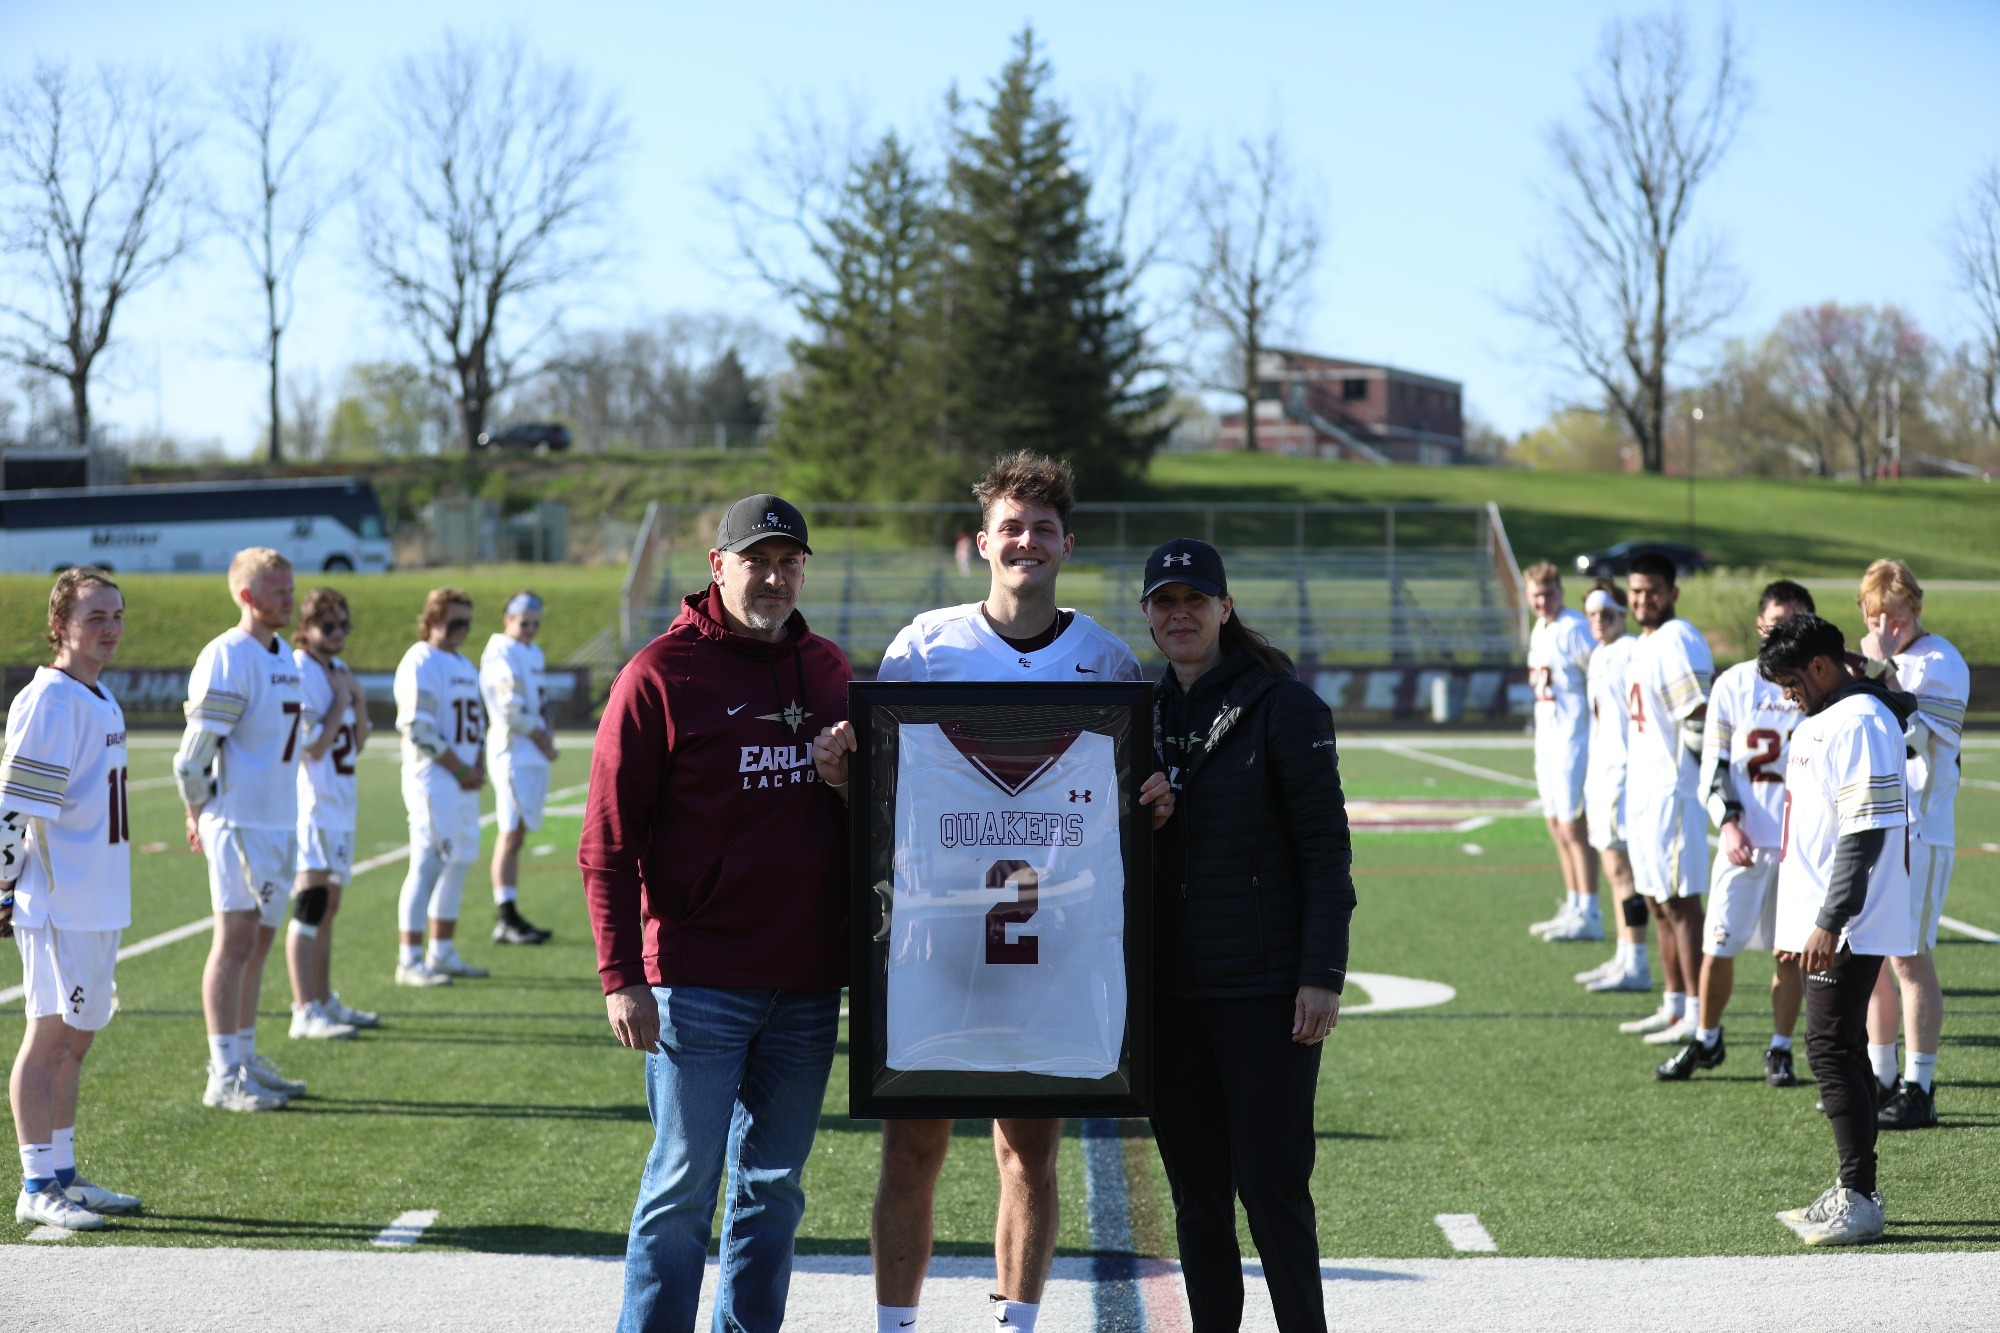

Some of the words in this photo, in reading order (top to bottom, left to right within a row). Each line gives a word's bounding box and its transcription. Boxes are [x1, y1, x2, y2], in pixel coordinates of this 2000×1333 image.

[282, 702, 301, 763] 7
[452, 699, 479, 744] 15
[1746, 729, 1793, 784] 2
[940, 811, 1084, 848] QUAKERS
[985, 859, 1039, 965] 2
